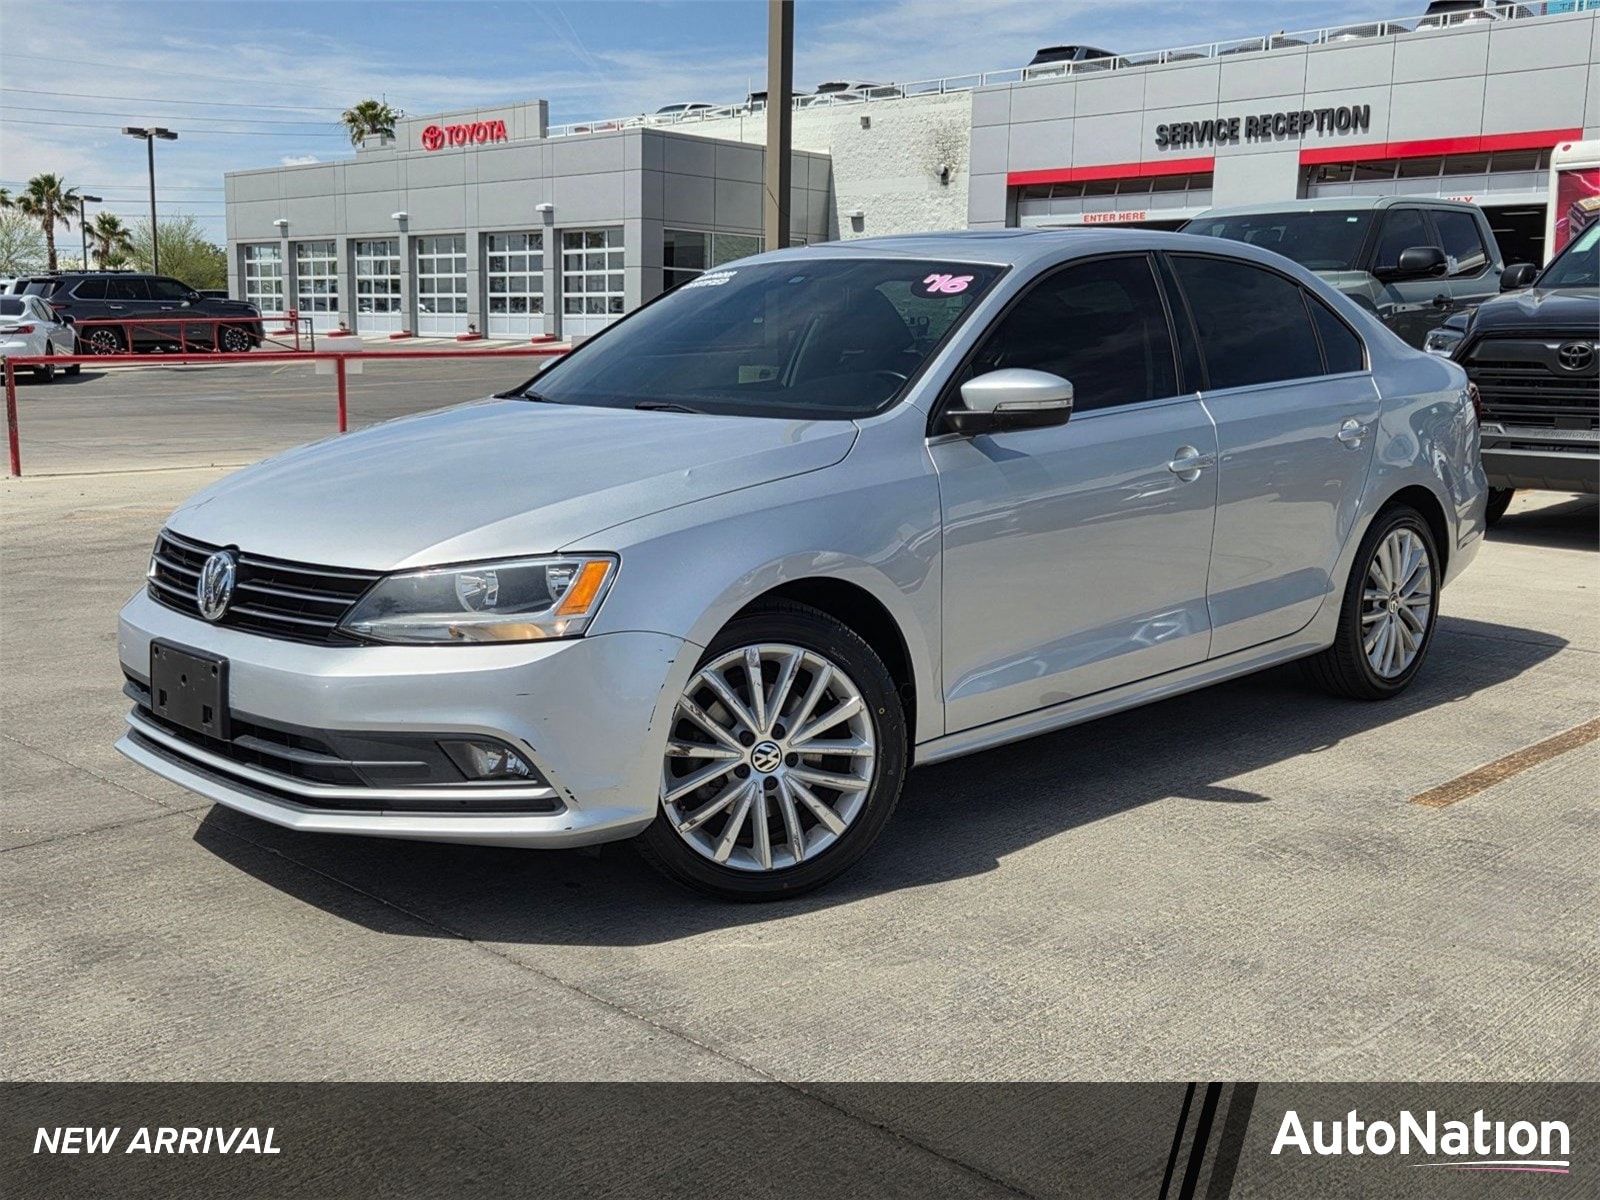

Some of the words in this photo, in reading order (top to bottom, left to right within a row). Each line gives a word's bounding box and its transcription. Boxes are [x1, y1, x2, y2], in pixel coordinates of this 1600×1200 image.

[445, 119, 508, 147] TOYOTA
[1155, 117, 1241, 147] SERVICE
[1244, 104, 1371, 139] RECEPTION
[1083, 214, 1116, 223] ENTER
[1118, 211, 1146, 221] HERE
